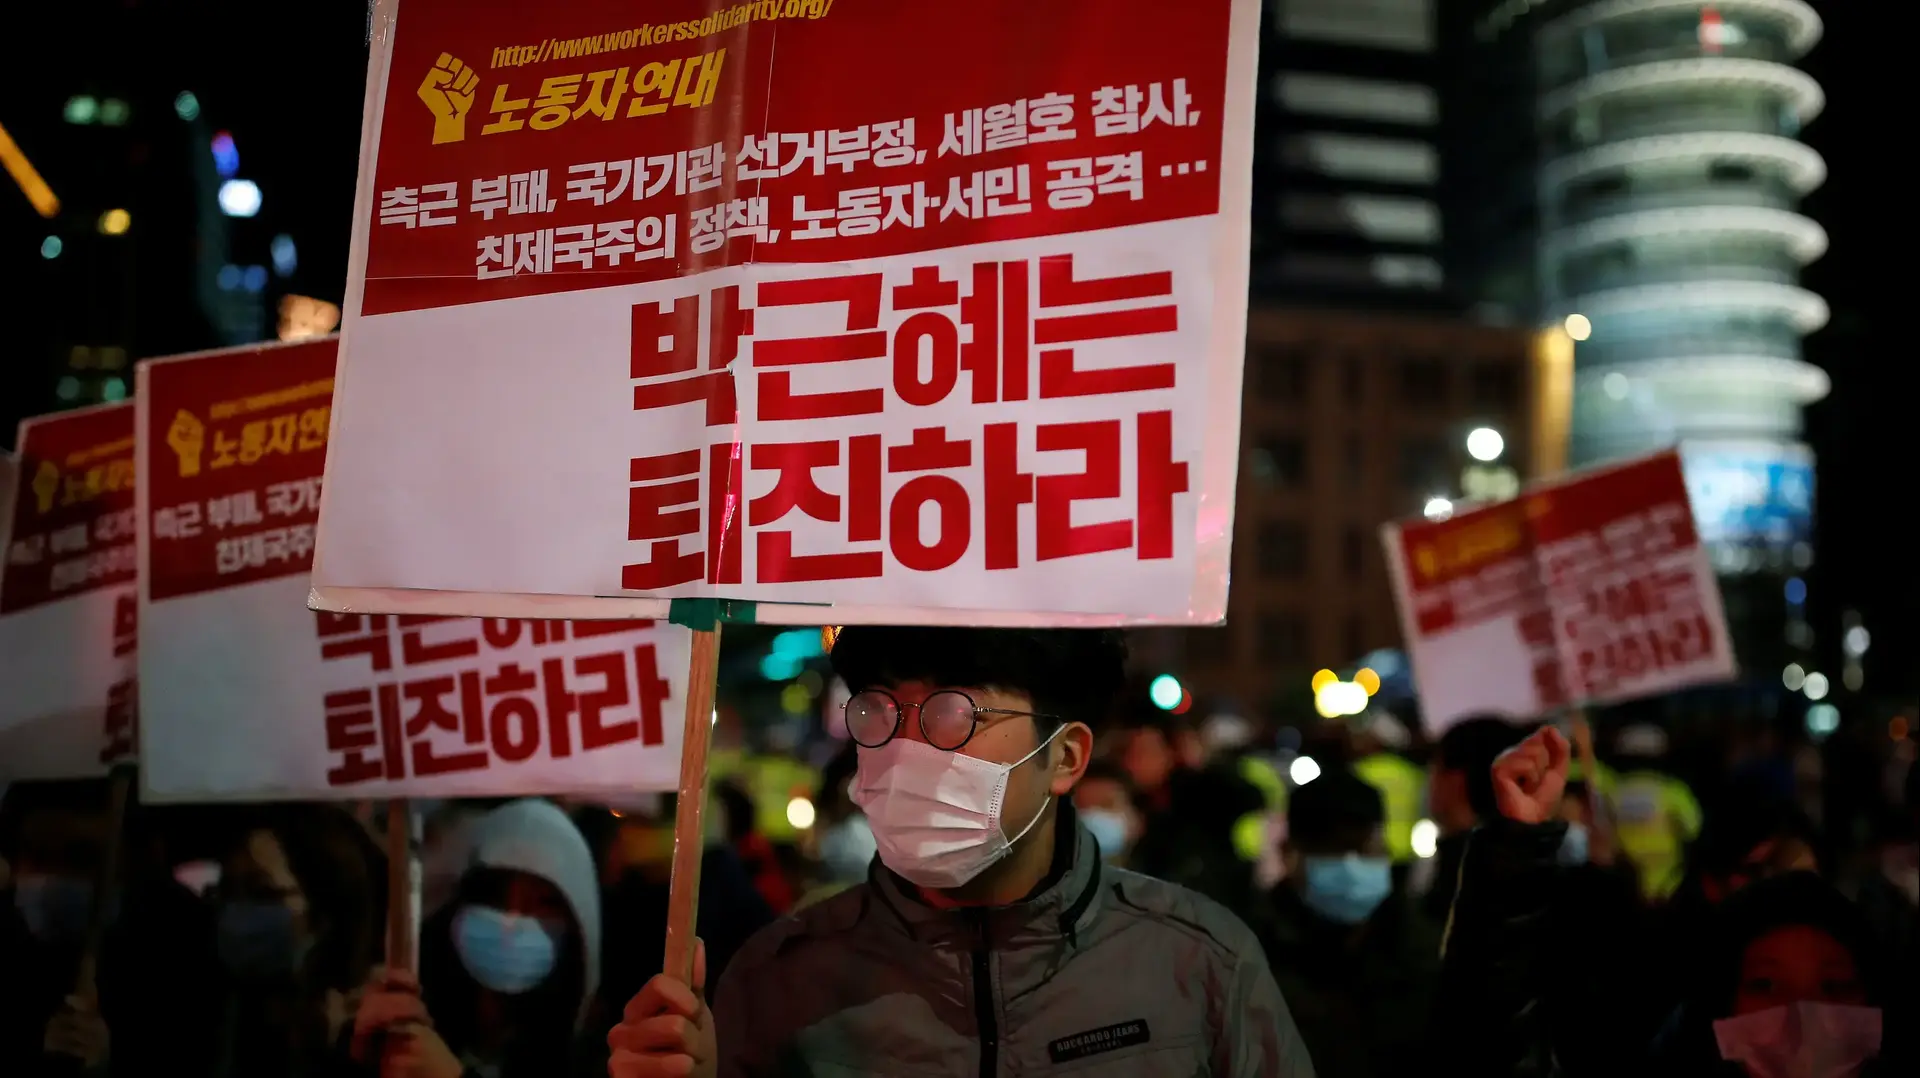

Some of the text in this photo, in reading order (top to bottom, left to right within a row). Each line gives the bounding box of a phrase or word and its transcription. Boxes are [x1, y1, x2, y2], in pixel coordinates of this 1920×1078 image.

[480, 48, 727, 136] 노동자연대
[491, 0, 833, 69] http://www.workerssolidarity.org/
[379, 78, 1201, 229] 측근 부패, 국가기관 선거부정, 세월호 참사,
[476, 213, 677, 280] 친제국주의
[690, 196, 781, 255] 정책,
[1046, 151, 1143, 210] 공격
[630, 253, 1178, 427] 박근혜는
[622, 409, 1189, 590] 퇴진하라
[323, 644, 671, 786] 퇴진하라
